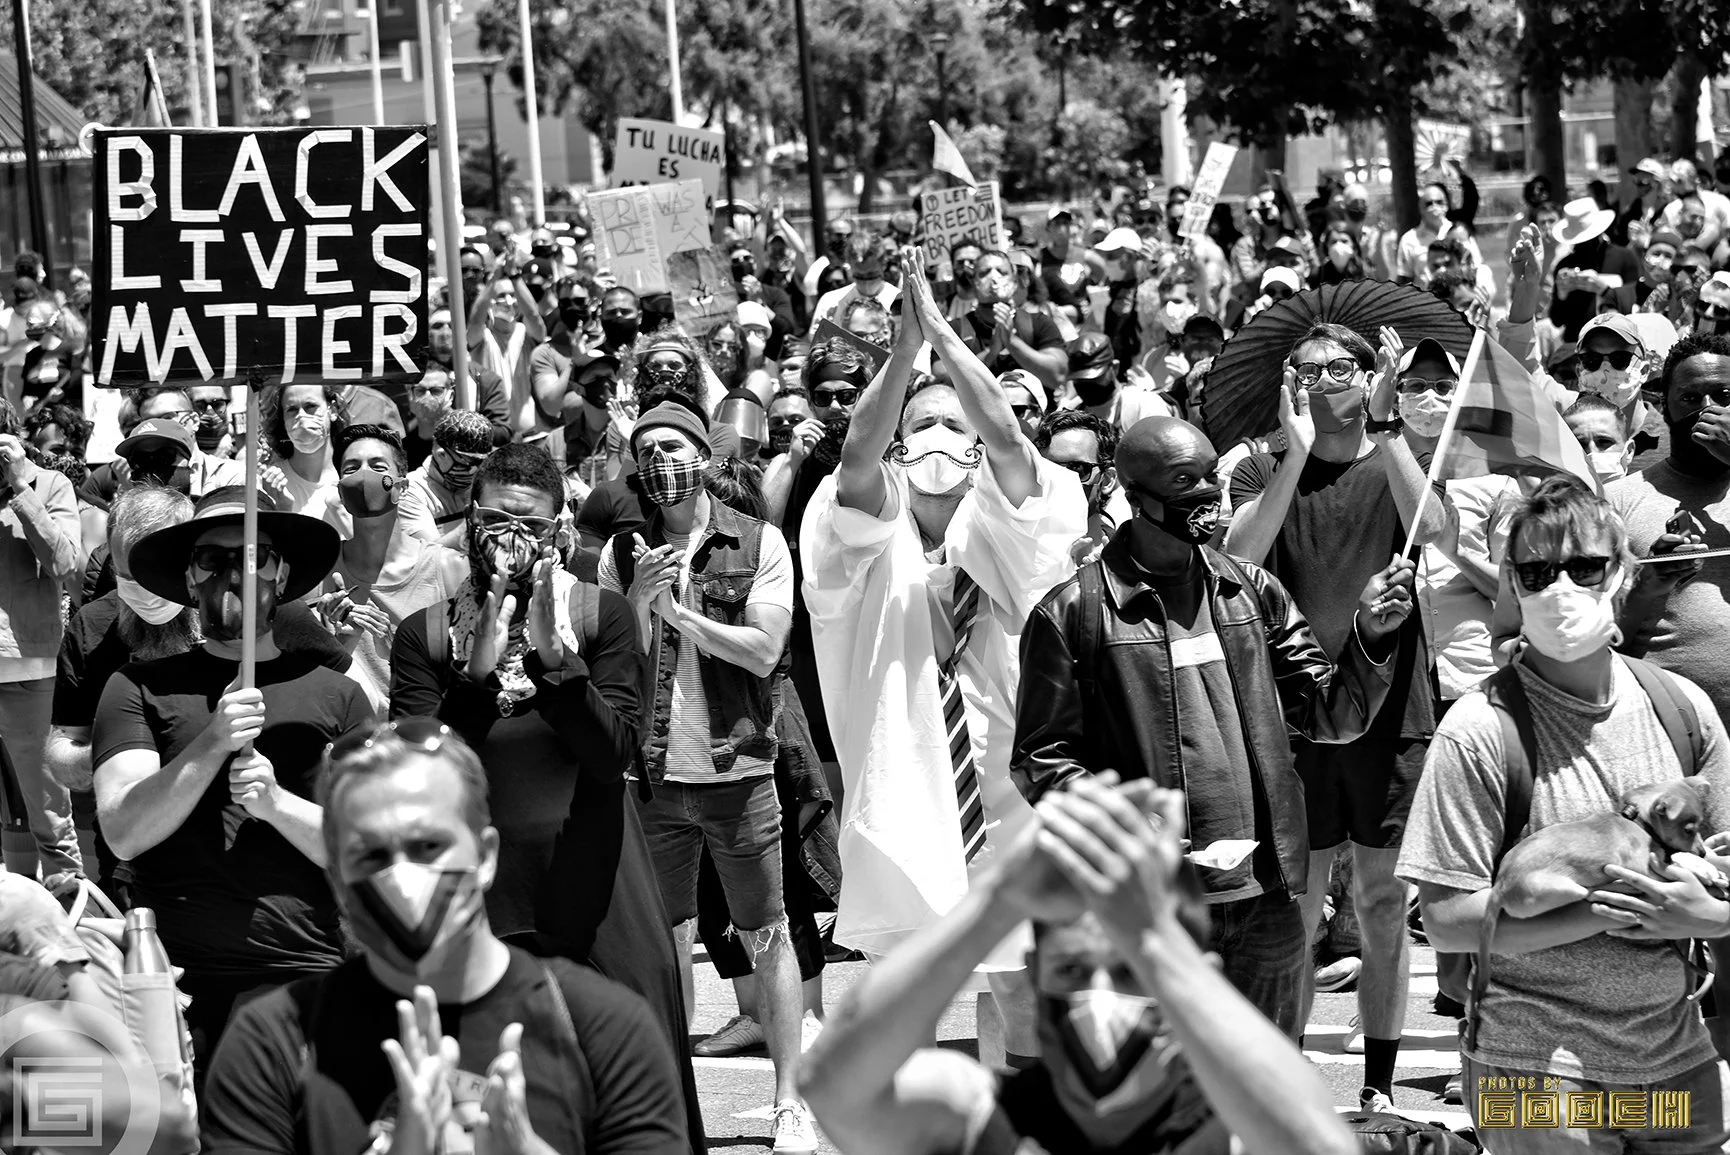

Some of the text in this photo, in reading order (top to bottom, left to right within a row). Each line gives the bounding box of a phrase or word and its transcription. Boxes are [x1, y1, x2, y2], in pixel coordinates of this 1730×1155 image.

[626, 127, 721, 164] TU LUCHA
[107, 125, 427, 222] BLACK
[658, 157, 680, 178] ES
[653, 188, 695, 216] WAS
[944, 188, 968, 204] LET
[924, 203, 996, 234] FREEDOM
[110, 223, 423, 304] LIVES
[97, 301, 422, 384] MATTER
